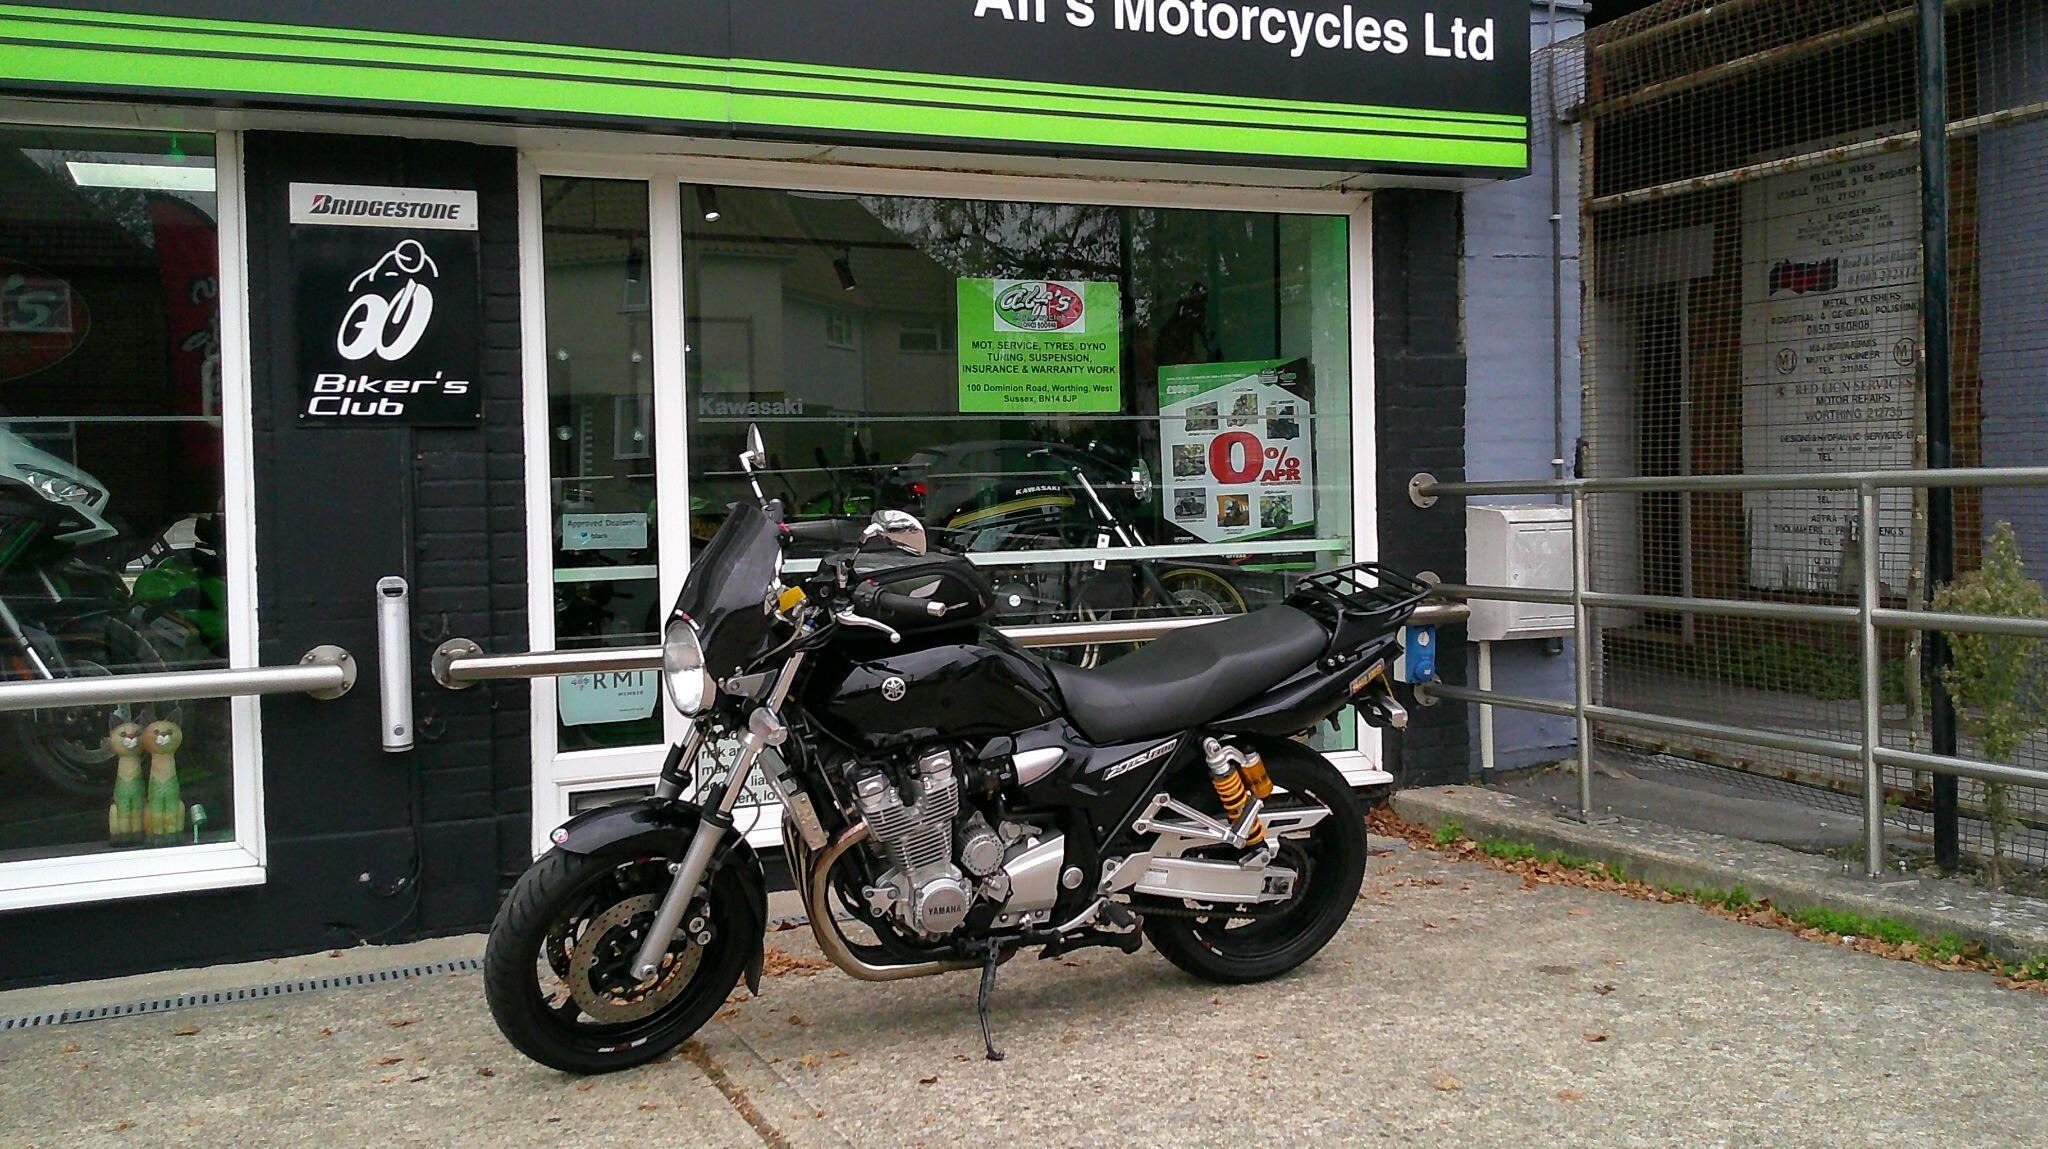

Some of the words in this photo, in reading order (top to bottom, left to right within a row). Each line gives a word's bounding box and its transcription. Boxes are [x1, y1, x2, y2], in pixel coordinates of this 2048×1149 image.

[1115, 0, 1409, 58] Motorcycles
[1424, 12, 1496, 61] Ltd
[309, 195, 460, 220] BRIDGESTONE
[971, 341, 994, 351] MOT,
[997, 341, 1041, 351] SERVICE,
[1044, 342, 1075, 351] TYRES,
[1080, 342, 1106, 351] DYNO
[987, 353, 1026, 362] TUNING,
[1029, 353, 1092, 363] SUSPENSION,
[962, 365, 1019, 374] INSURANCE
[1022, 366, 1028, 374] &
[1031, 366, 1084, 374] WARRANTY
[1087, 366, 1116, 374] WORK
[313, 371, 469, 394] Biker's
[967, 384, 981, 392] 100
[983, 384, 1024, 392] Dominion
[1039, 395, 1061, 403] BN14
[308, 396, 404, 416] Club
[700, 399, 803, 415] Kawasaki
[1818, 453, 1832, 461] TEL
[1260, 468, 1302, 482] APR
[1015, 485, 1061, 495] KAWASAKI
[593, 671, 644, 690] RMI
[928, 905, 962, 915] YAMAHA
